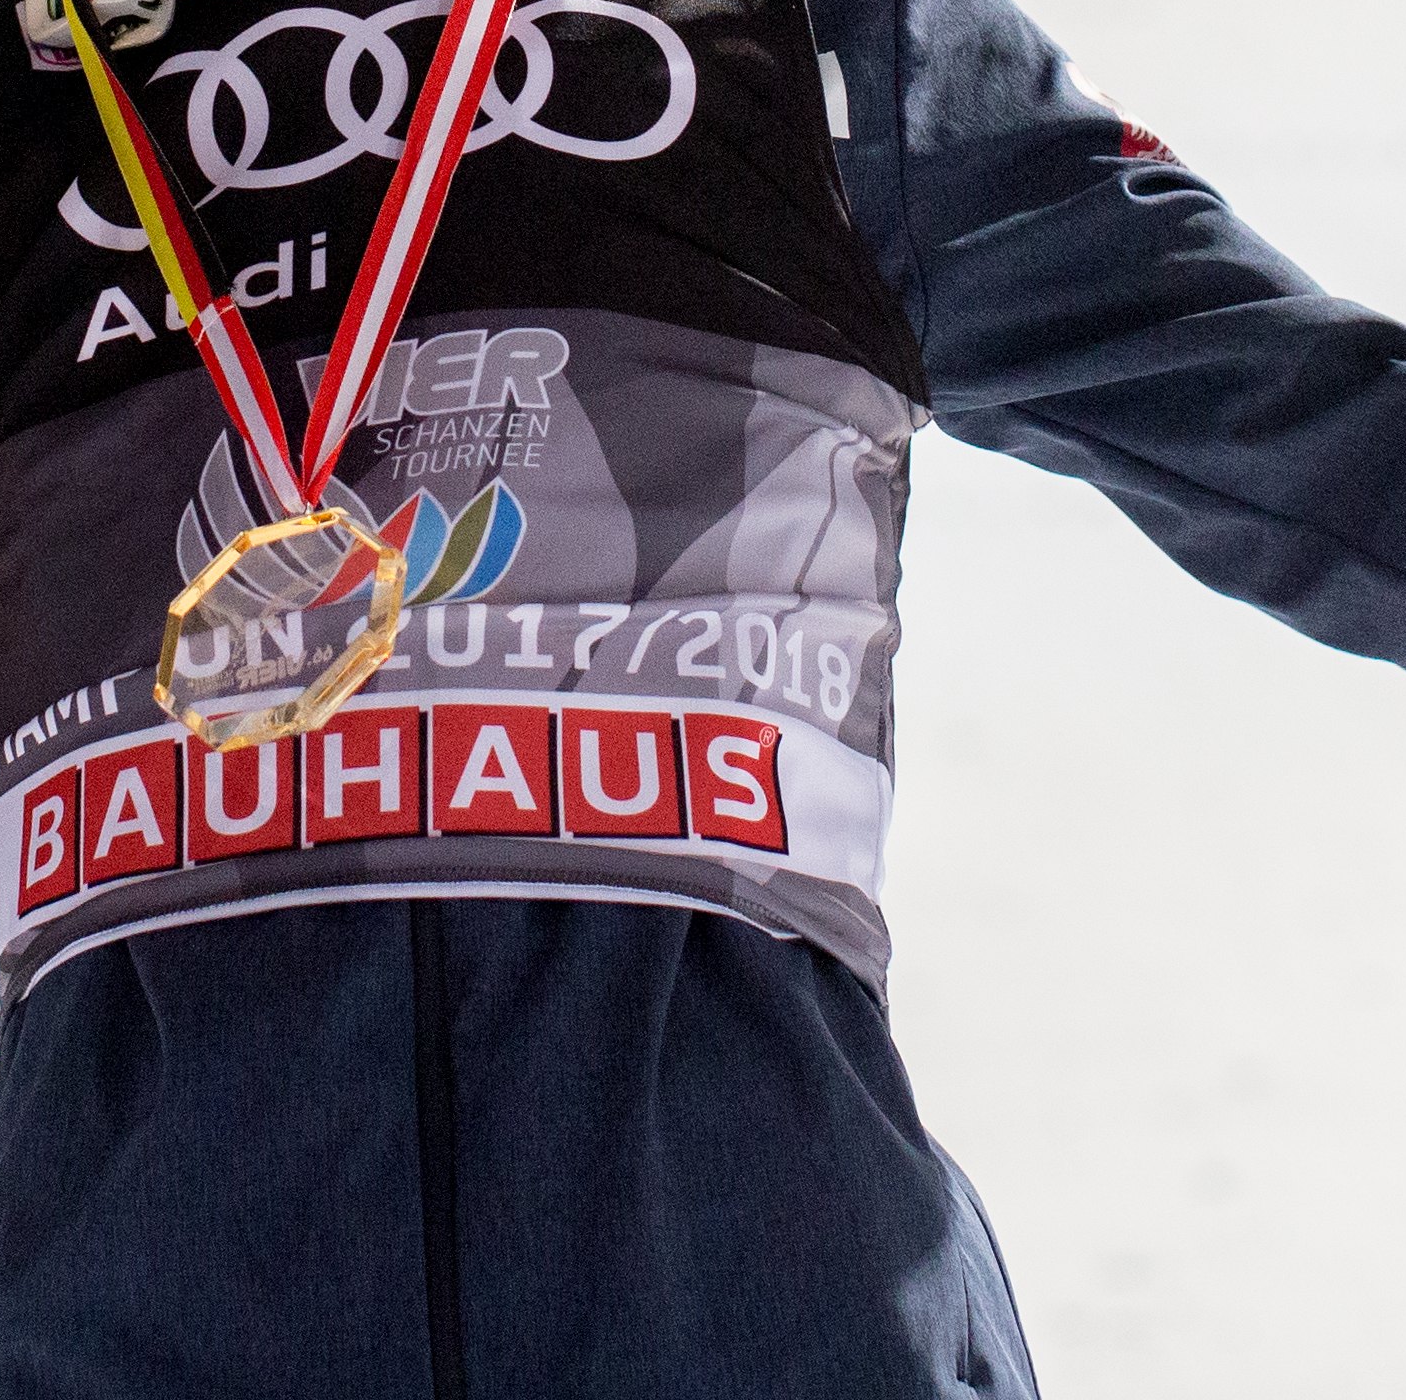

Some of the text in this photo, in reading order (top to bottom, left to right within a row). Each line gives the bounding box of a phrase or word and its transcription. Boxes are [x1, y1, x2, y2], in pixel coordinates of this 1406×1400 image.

[296, 327, 570, 428] IER
[373, 413, 551, 455] SCHANZEN
[391, 442, 546, 481] TOURNEE
[25, 724, 769, 890] BAUHAUS
